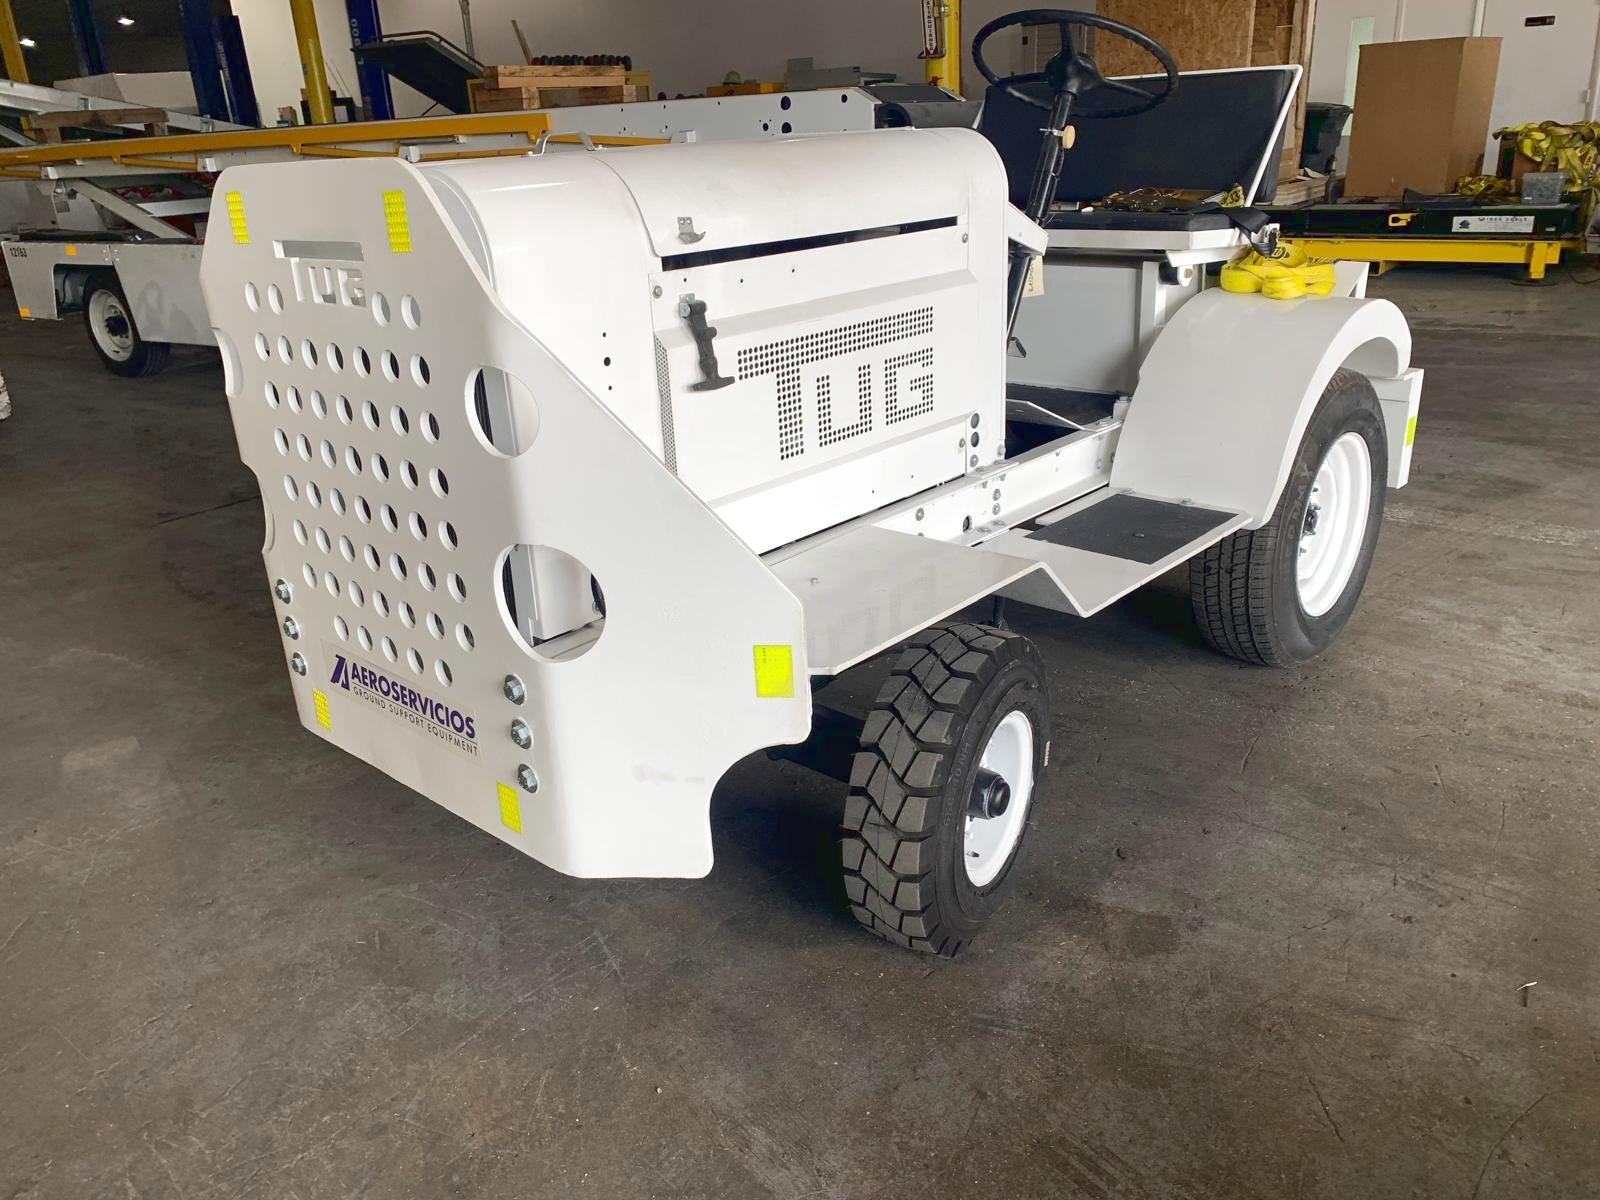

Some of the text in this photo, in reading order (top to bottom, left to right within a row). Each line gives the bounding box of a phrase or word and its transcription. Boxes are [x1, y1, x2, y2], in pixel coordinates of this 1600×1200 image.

[272, 240, 366, 308] TUG
[736, 305, 934, 461] TUG
[351, 662, 476, 739] AEROSERVICIOS
[353, 686, 478, 757] GROUND SUPPORT EQUIPMENT
